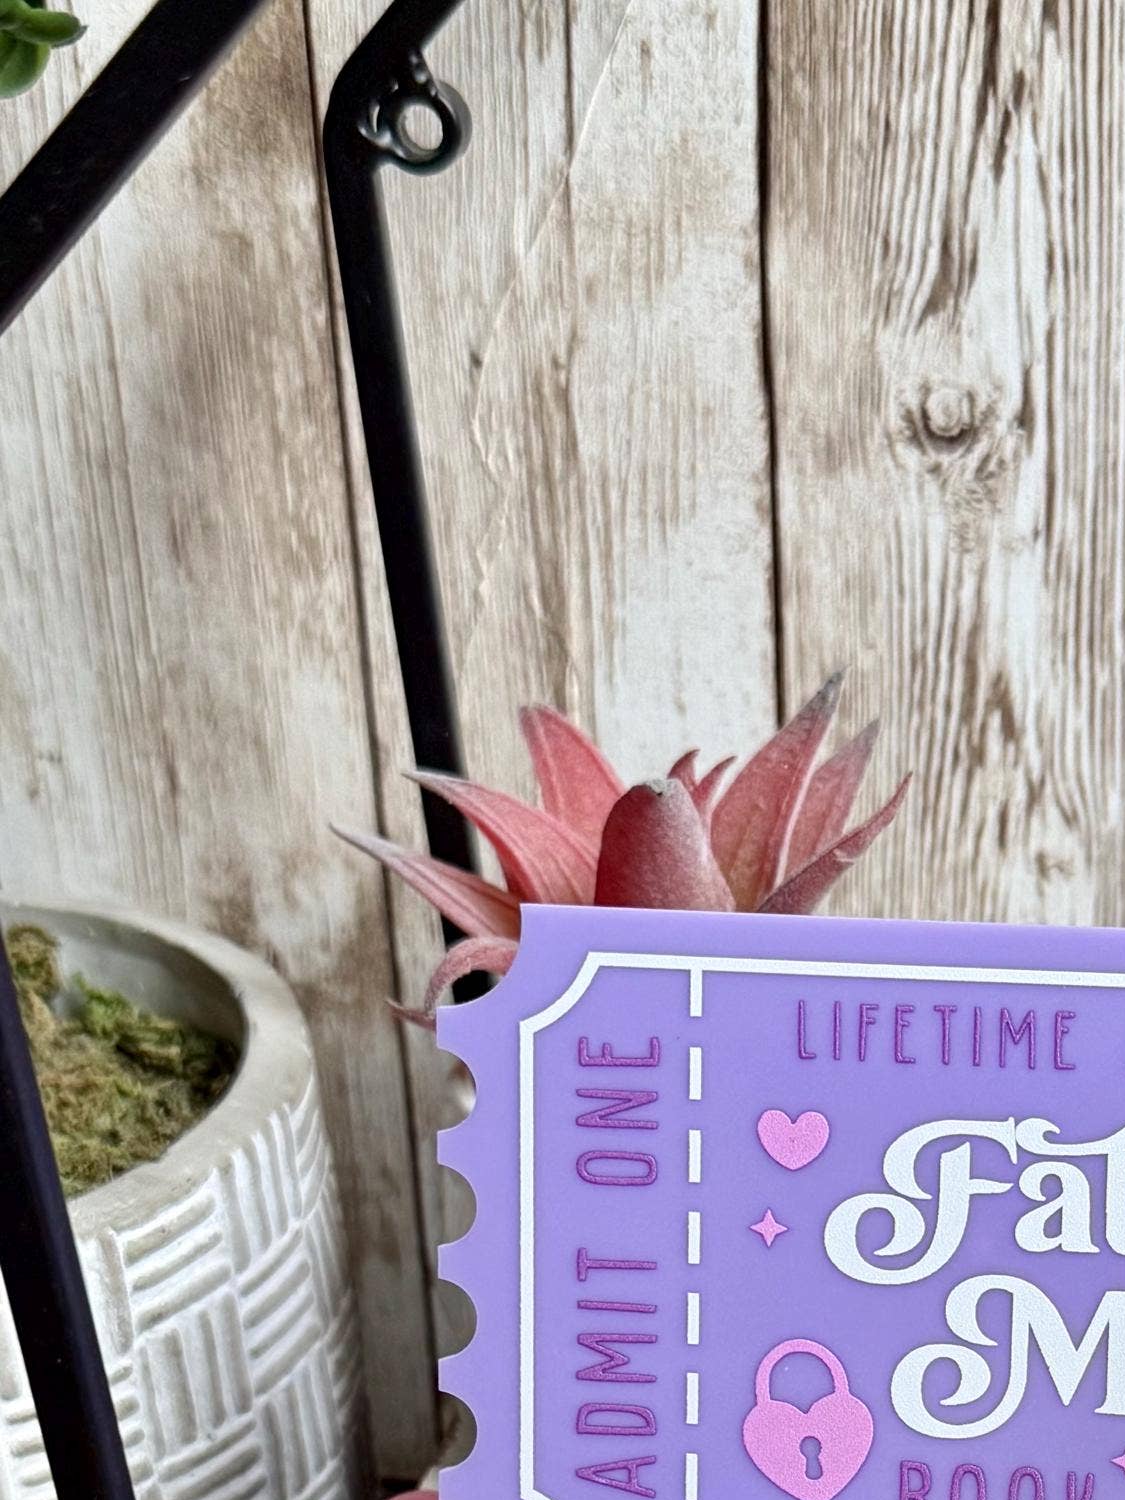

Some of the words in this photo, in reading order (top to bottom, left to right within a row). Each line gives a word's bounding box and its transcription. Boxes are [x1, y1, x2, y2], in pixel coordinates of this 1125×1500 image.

[575, 1034, 661, 1189] ONE
[798, 1000, 1077, 1072] LIFETIME
[575, 1248, 660, 1500] ADMIT
